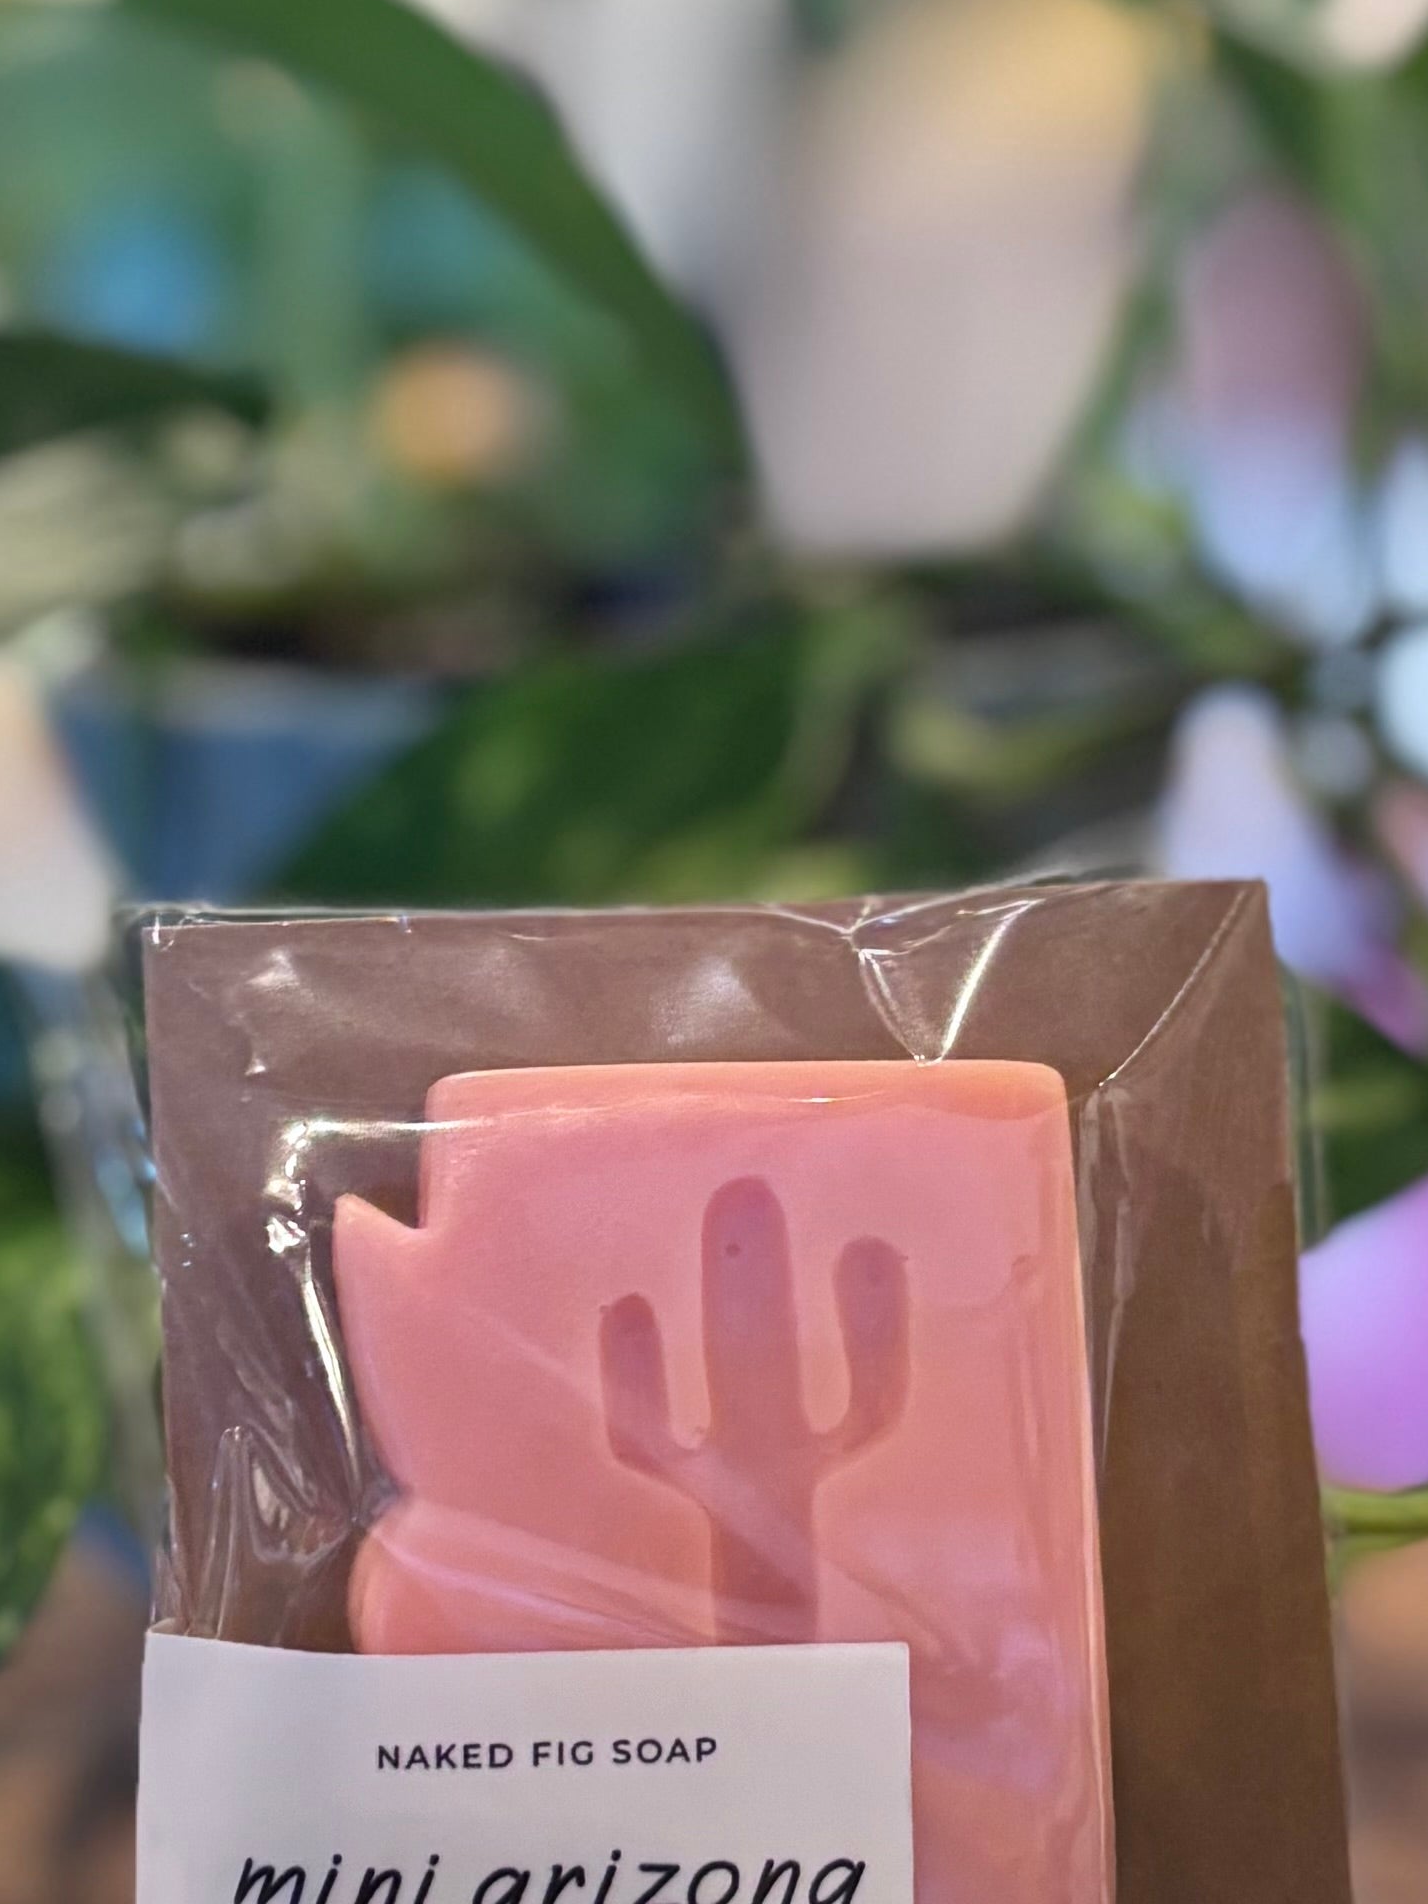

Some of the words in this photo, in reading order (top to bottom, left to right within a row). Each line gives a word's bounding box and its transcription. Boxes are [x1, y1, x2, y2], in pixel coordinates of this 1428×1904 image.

[377, 1742, 514, 1771] NAKED
[532, 1740, 594, 1768] FIG
[612, 1736, 717, 1765] SOAP
